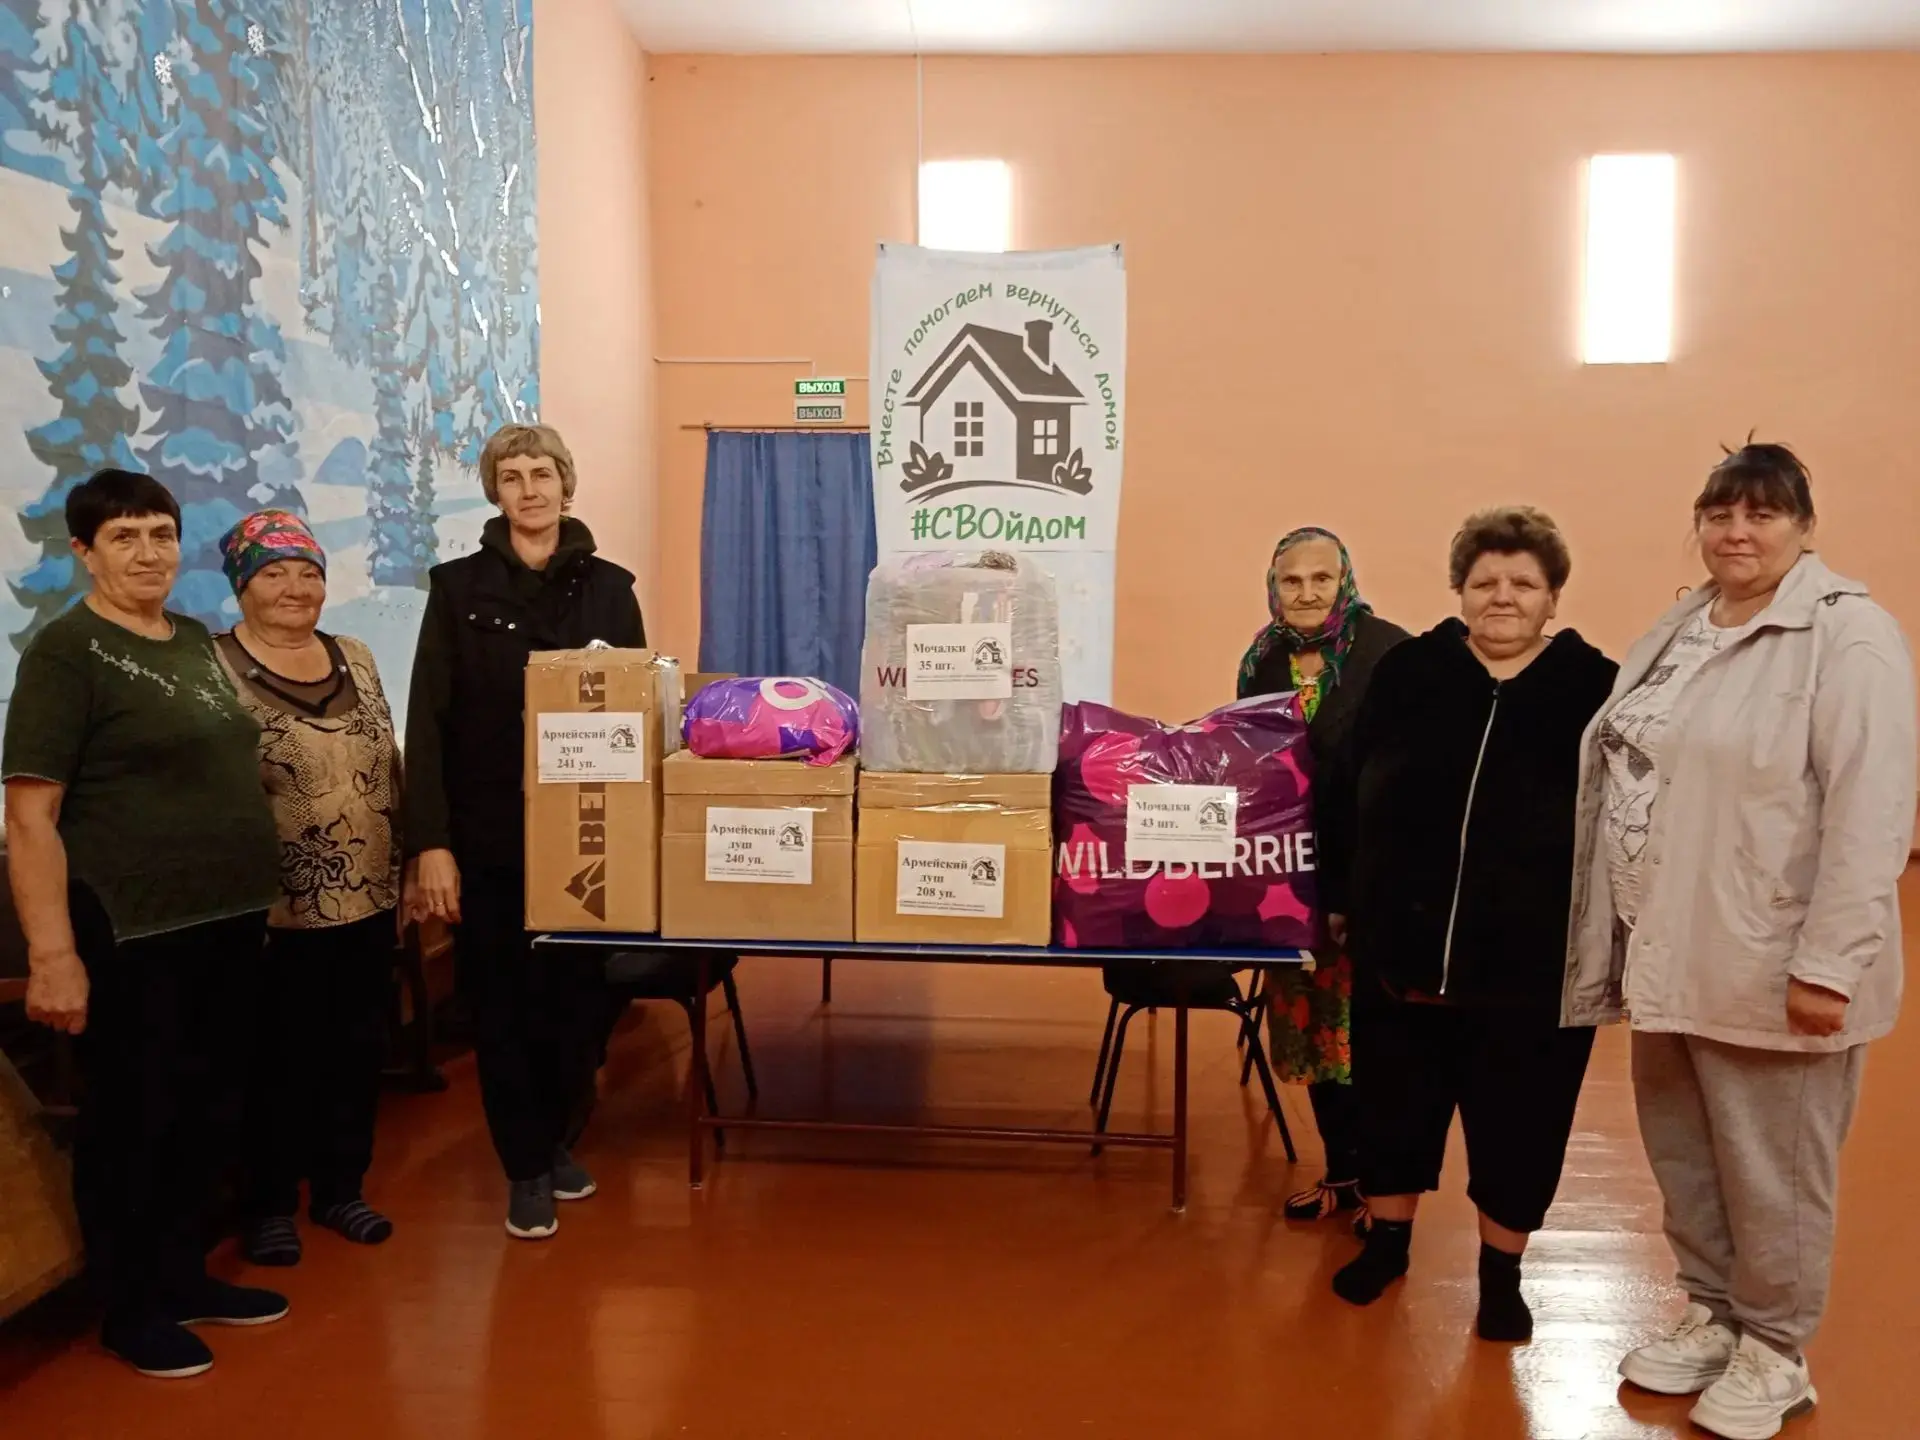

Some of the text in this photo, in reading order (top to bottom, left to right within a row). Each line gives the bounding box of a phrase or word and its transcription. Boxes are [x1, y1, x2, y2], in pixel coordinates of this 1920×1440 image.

[878, 282, 1120, 470] Вместе помогаем вернуться домой
[799, 382, 841, 393] ВЫХОД
[799, 407, 840, 418] ВЫХОД
[913, 643, 966, 654] Мочалки
[919, 660, 955, 671] 35 шт.
[542, 728, 606, 742] Армейский
[559, 745, 583, 757] душ
[556, 758, 596, 771] 241 уп.
[1135, 801, 1191, 812] Мочалки
[1141, 817, 1179, 829] 43 шт.
[710, 824, 776, 837] Армейский
[728, 840, 752, 852] душ
[725, 853, 764, 867] 240 уп.
[901, 857, 968, 870] Армейский
[919, 874, 944, 885] душ
[916, 886, 956, 900] 208 уп.
